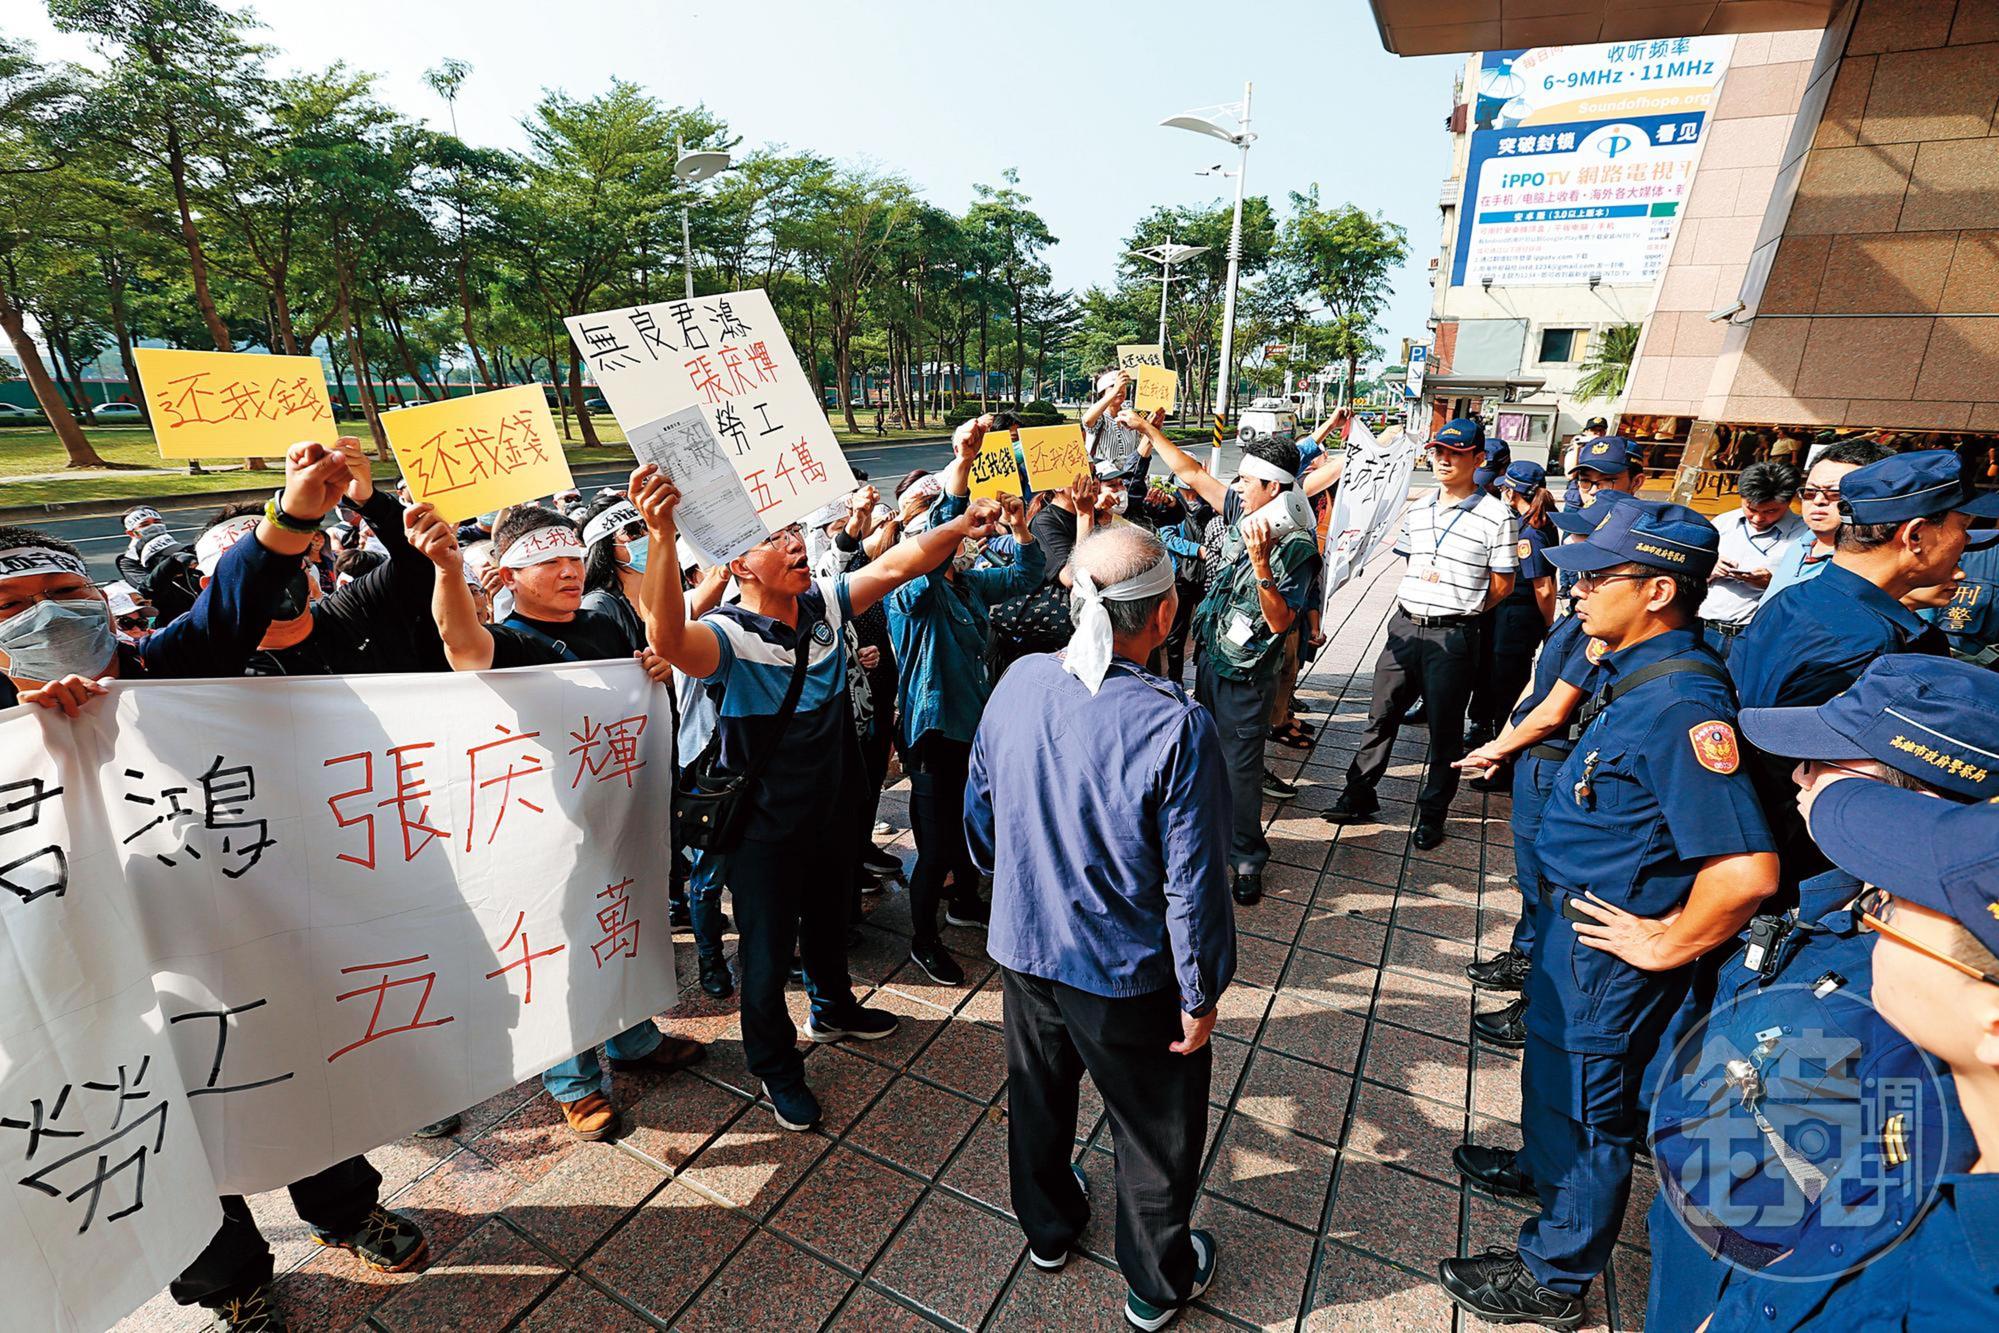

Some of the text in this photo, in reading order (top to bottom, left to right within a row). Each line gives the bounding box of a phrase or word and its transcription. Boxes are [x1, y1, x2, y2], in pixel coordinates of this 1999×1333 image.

[1608, 37, 1690, 63] 收听频率
[1578, 93, 1712, 114] Soundofhope.org
[1498, 122, 1697, 155] 突破封锁 看见
[1502, 171, 1571, 188] iPPOTV
[579, 298, 752, 371] 無良君鴻
[1411, 347, 1423, 361] P
[744, 436, 828, 513] 五千萬
[1946, 585, 1982, 630] 刑警
[1889, 735, 1988, 783] 高雄市政府警察局
[328, 876, 640, 1063] 五千萬
